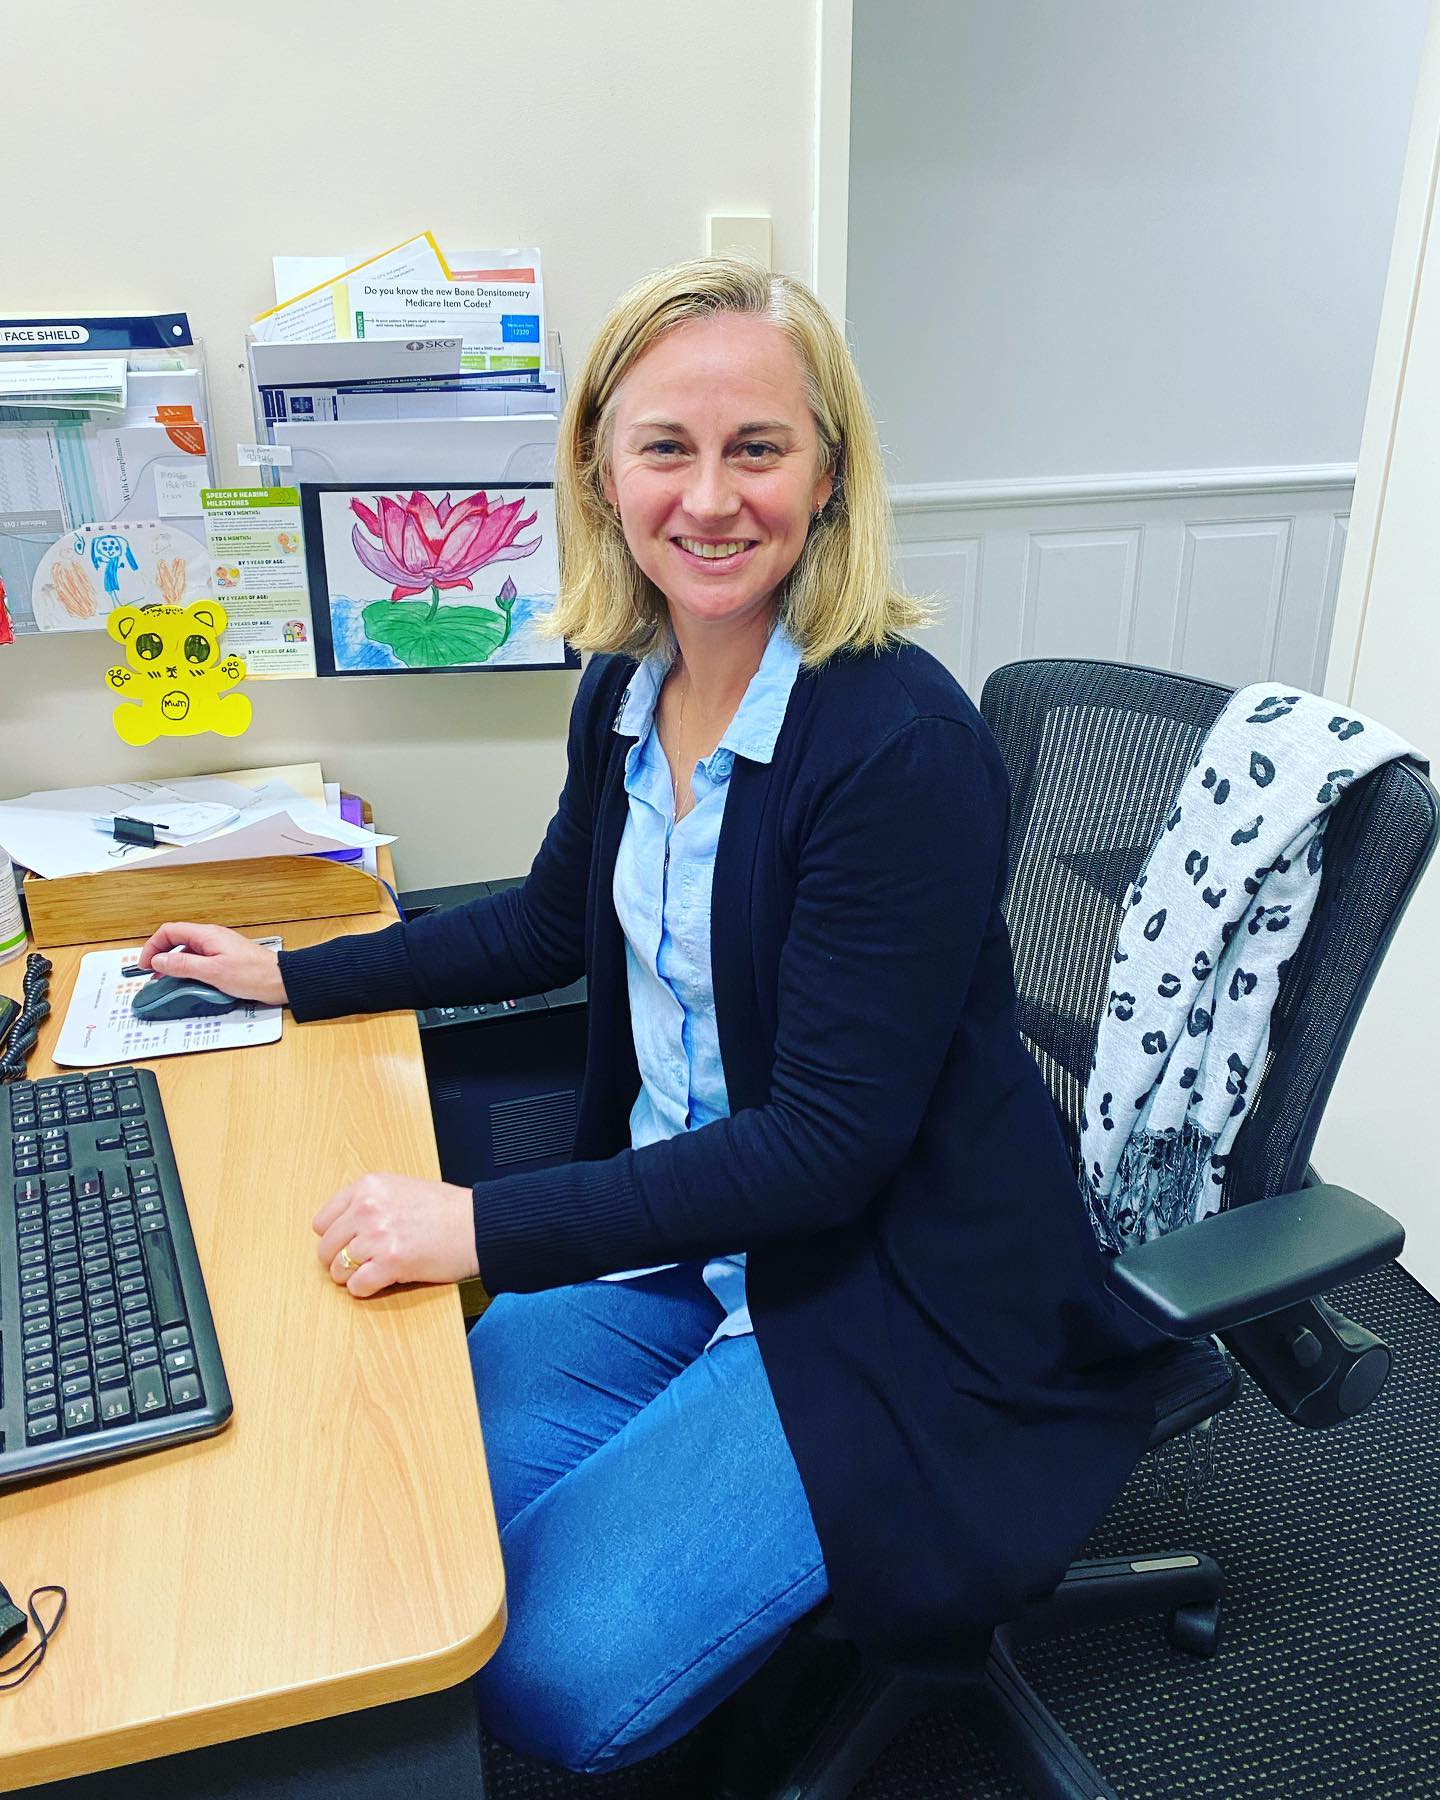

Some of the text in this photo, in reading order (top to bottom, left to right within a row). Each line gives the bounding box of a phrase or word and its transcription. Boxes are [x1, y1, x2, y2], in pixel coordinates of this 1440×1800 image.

[364, 286, 530, 298] Do you know the new Bone Densitometry
[405, 298, 492, 308] Medicare Item Codes?
[4, 330, 80, 341] FACE SHIELD
[425, 339, 456, 348] SKG
[115, 438, 131, 502] With Compliments
[205, 491, 233, 499] SPEECH
[239, 490, 269, 498] HEARING
[206, 499, 249, 507] MILESTONES
[164, 699, 187, 708] Mum
